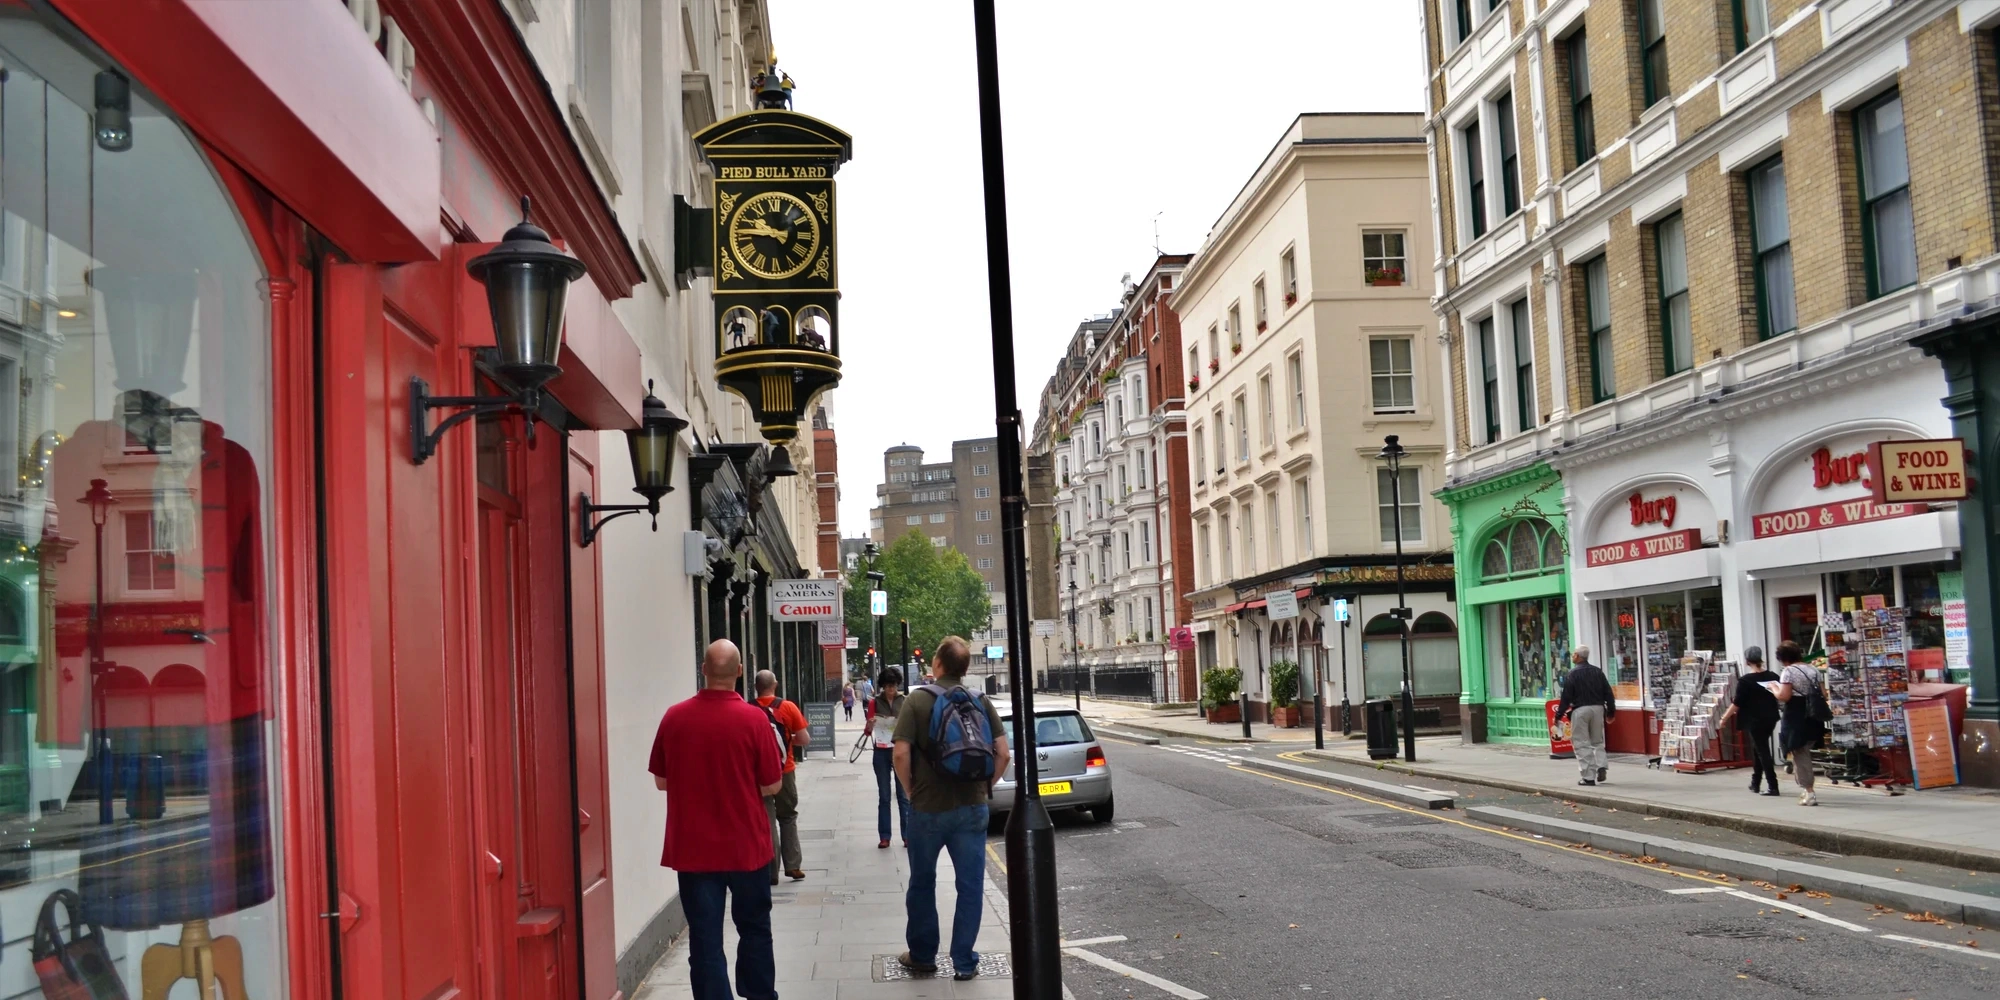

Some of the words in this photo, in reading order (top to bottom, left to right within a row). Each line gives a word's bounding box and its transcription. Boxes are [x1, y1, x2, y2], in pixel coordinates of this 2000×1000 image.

[721, 166, 752, 178] PIED
[755, 166, 789, 178] BULL
[791, 166, 827, 178] YARD
[751, 203, 766, 218] XI
[767, 199, 781, 213] XII
[784, 203, 794, 216] I
[793, 215, 808, 226] II
[797, 231, 812, 240] III
[753, 252, 767, 270] VII
[771, 257, 781, 272] VI
[785, 254, 796, 268] V
[1896, 450, 1949, 469] FOOD
[1890, 475, 1904, 492] &
[1907, 472, 1961, 491] WINE
[1629, 493, 1676, 528] Bury
[1760, 510, 1810, 535] FOOD
[1818, 508, 1834, 526] &
[1842, 500, 1905, 522] WINE
[1591, 545, 1624, 564] FOOD
[1629, 543, 1640, 558] &
[1644, 534, 1685, 555] WINE
[775, 590, 835, 598] CAMERAS
[780, 604, 832, 616] Canon
[821, 635, 840, 643] Shop
[1946, 630, 1954, 638] Go
[1049, 784, 1065, 792] DRA
